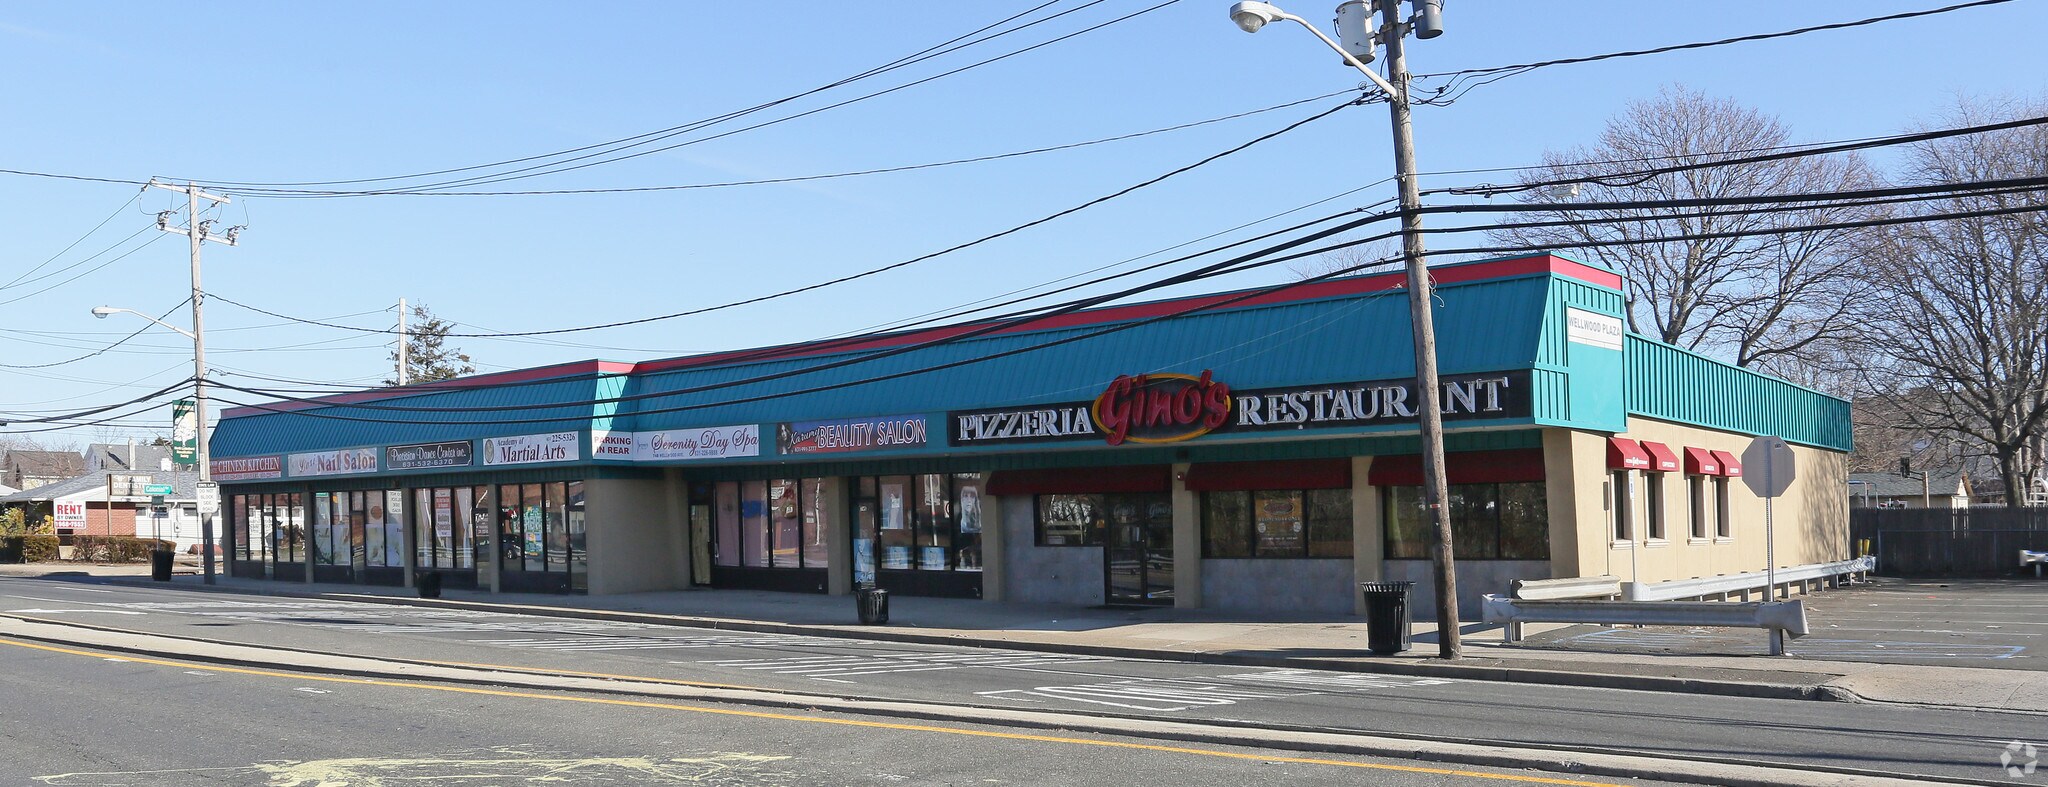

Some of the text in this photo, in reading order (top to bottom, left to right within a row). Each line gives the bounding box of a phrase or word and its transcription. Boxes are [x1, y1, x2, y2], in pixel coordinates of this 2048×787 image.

[1568, 316, 1621, 337] WELLWOOD PLAZA
[957, 370, 1509, 446] PIZZERIA Gino's RESTAURNT
[497, 438, 517, 447] Academy
[594, 437, 632, 446] PARKING
[651, 427, 758, 457] Serenity Day Spa
[818, 419, 927, 448] BEAUTY SALON
[391, 448, 416, 462] Precision
[416, 446, 436, 460] Dance
[436, 444, 455, 460] Center
[500, 444, 566, 462] Martial Arts
[597, 446, 630, 455] IN REAR
[218, 459, 247, 473] CHINESE
[247, 456, 280, 471] KITCHEN
[317, 454, 340, 472] Nail
[344, 452, 376, 471] Salon
[128, 475, 152, 483] FAMILY
[57, 504, 82, 515] RENT
